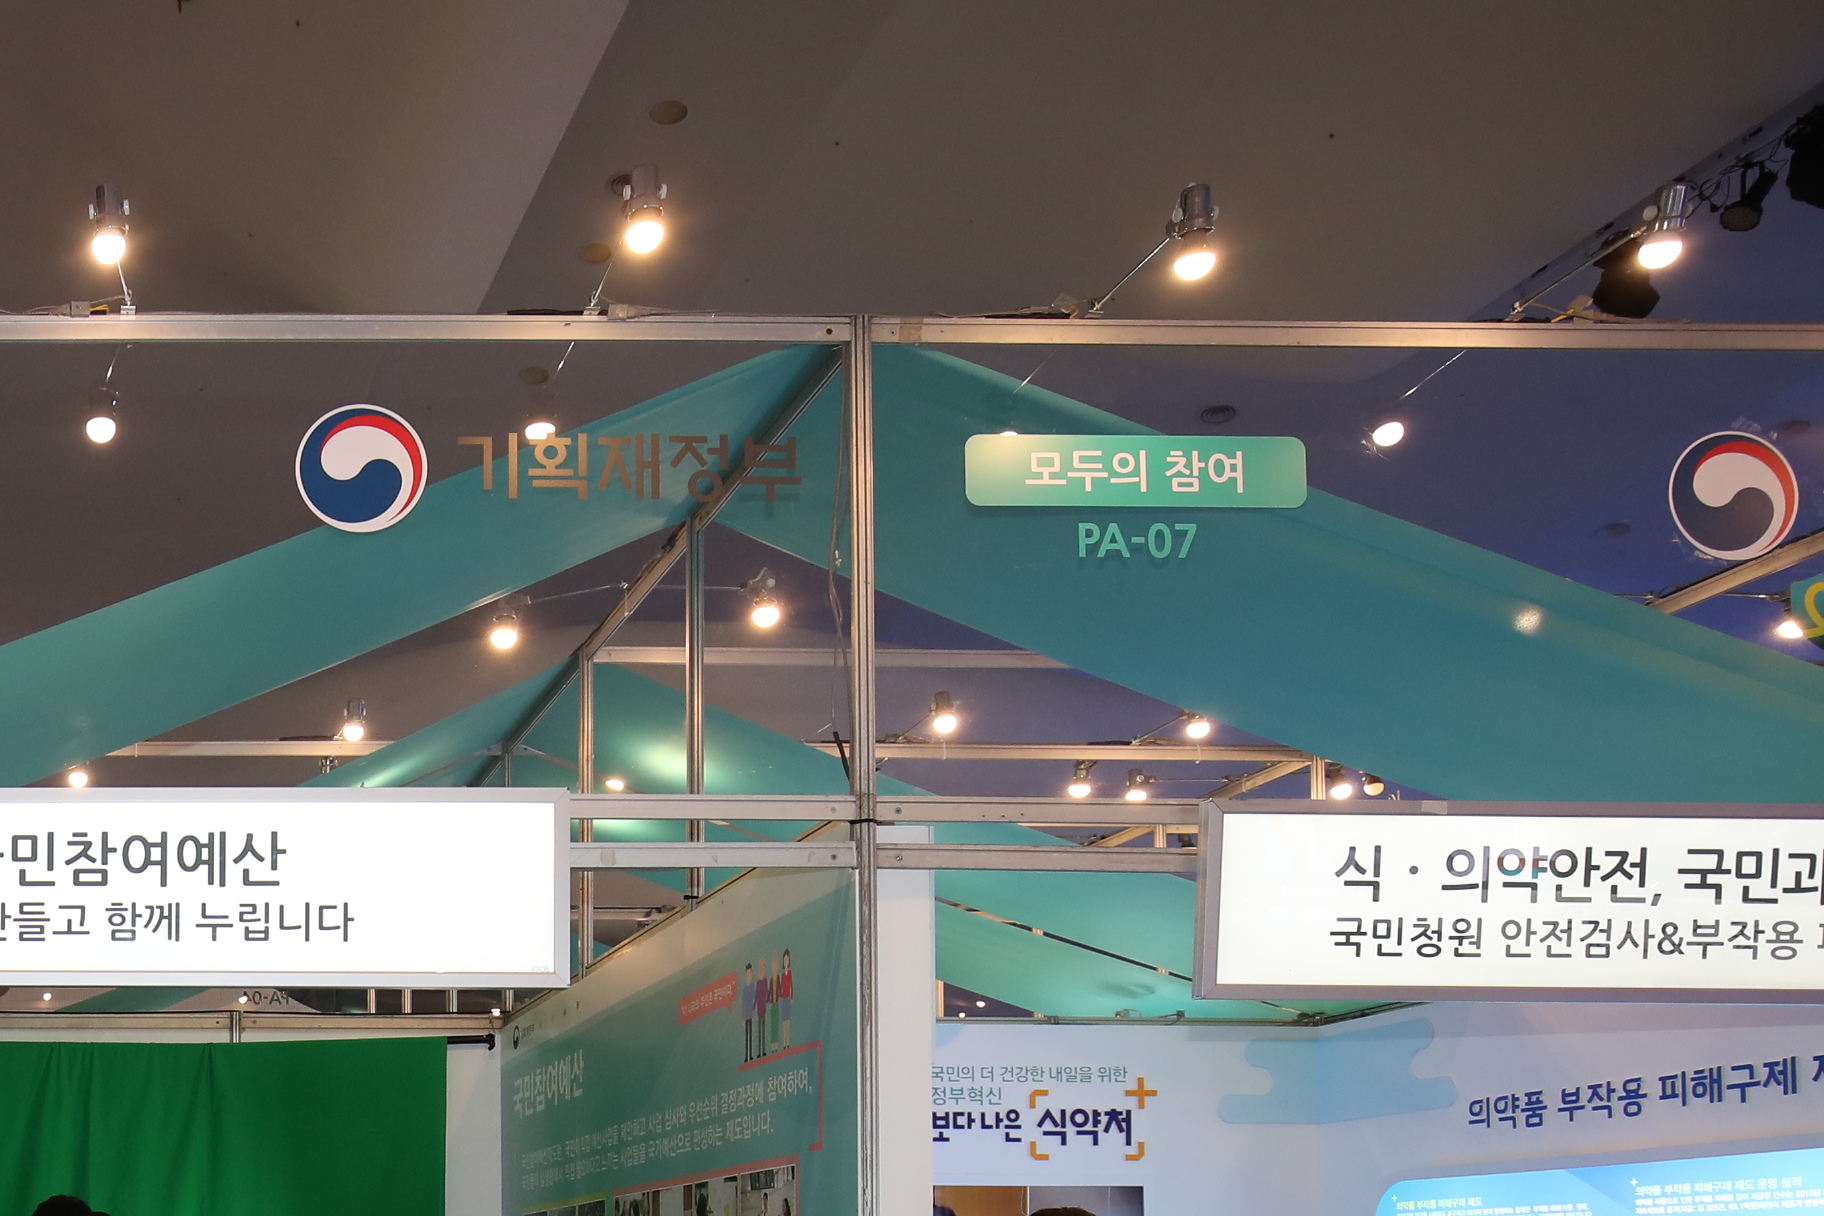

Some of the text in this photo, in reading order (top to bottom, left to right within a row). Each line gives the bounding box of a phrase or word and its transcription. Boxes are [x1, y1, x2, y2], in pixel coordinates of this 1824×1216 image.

[457, 432, 803, 503] 기획재정부
[1025, 446, 1247, 496] 모두의 참여
[1076, 520, 1198, 561] PA-07
[1334, 844, 1383, 904] 식
[1441, 845, 1663, 907] 의약안전,
[104, 901, 180, 944] 함께
[195, 901, 355, 944] 누립니다
[1329, 916, 1484, 960] 국민청원
[1500, 917, 1804, 962] 안전검사&부작용
[512, 1048, 585, 1119] 국민참여예산
[767, 1066, 813, 1102] 참여하여,
[932, 1066, 1128, 1084] 국민의 더 건강한 내일을 위한
[932, 1086, 1003, 1106] 정부혁신
[1468, 1089, 1549, 1130] 의약품
[1557, 1076, 1648, 1124] 부작용
[1658, 1054, 1798, 1108] 피해구제
[725, 1109, 774, 1143] 제도입니다.
[1037, 1108, 1133, 1147] 식약처
